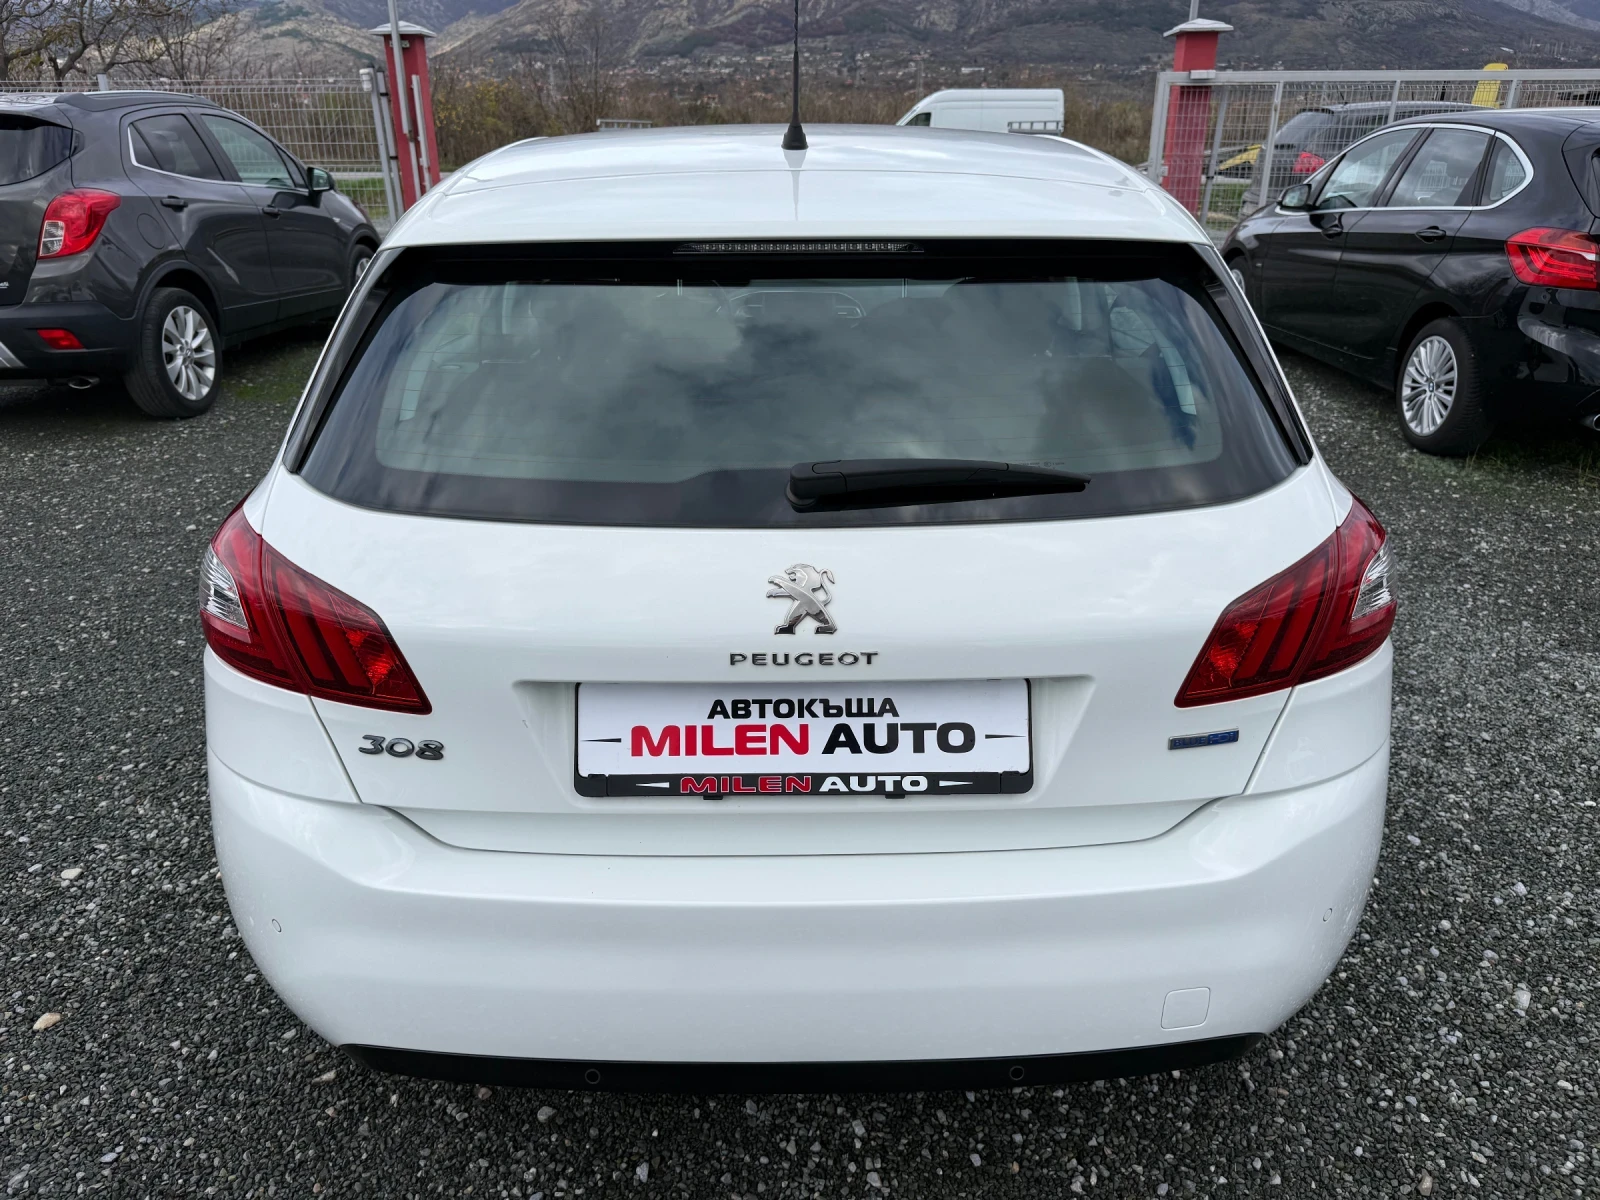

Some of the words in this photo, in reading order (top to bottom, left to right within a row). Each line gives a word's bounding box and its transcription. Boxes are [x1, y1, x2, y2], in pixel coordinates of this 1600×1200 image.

[730, 651, 878, 666] PEUGEOT
[707, 698, 899, 719] АВТОКЪША
[358, 734, 444, 760] 308
[631, 724, 809, 757] MILEN
[821, 722, 976, 754] AUTO
[680, 776, 811, 793] MILEN
[819, 775, 928, 792] AUTO
